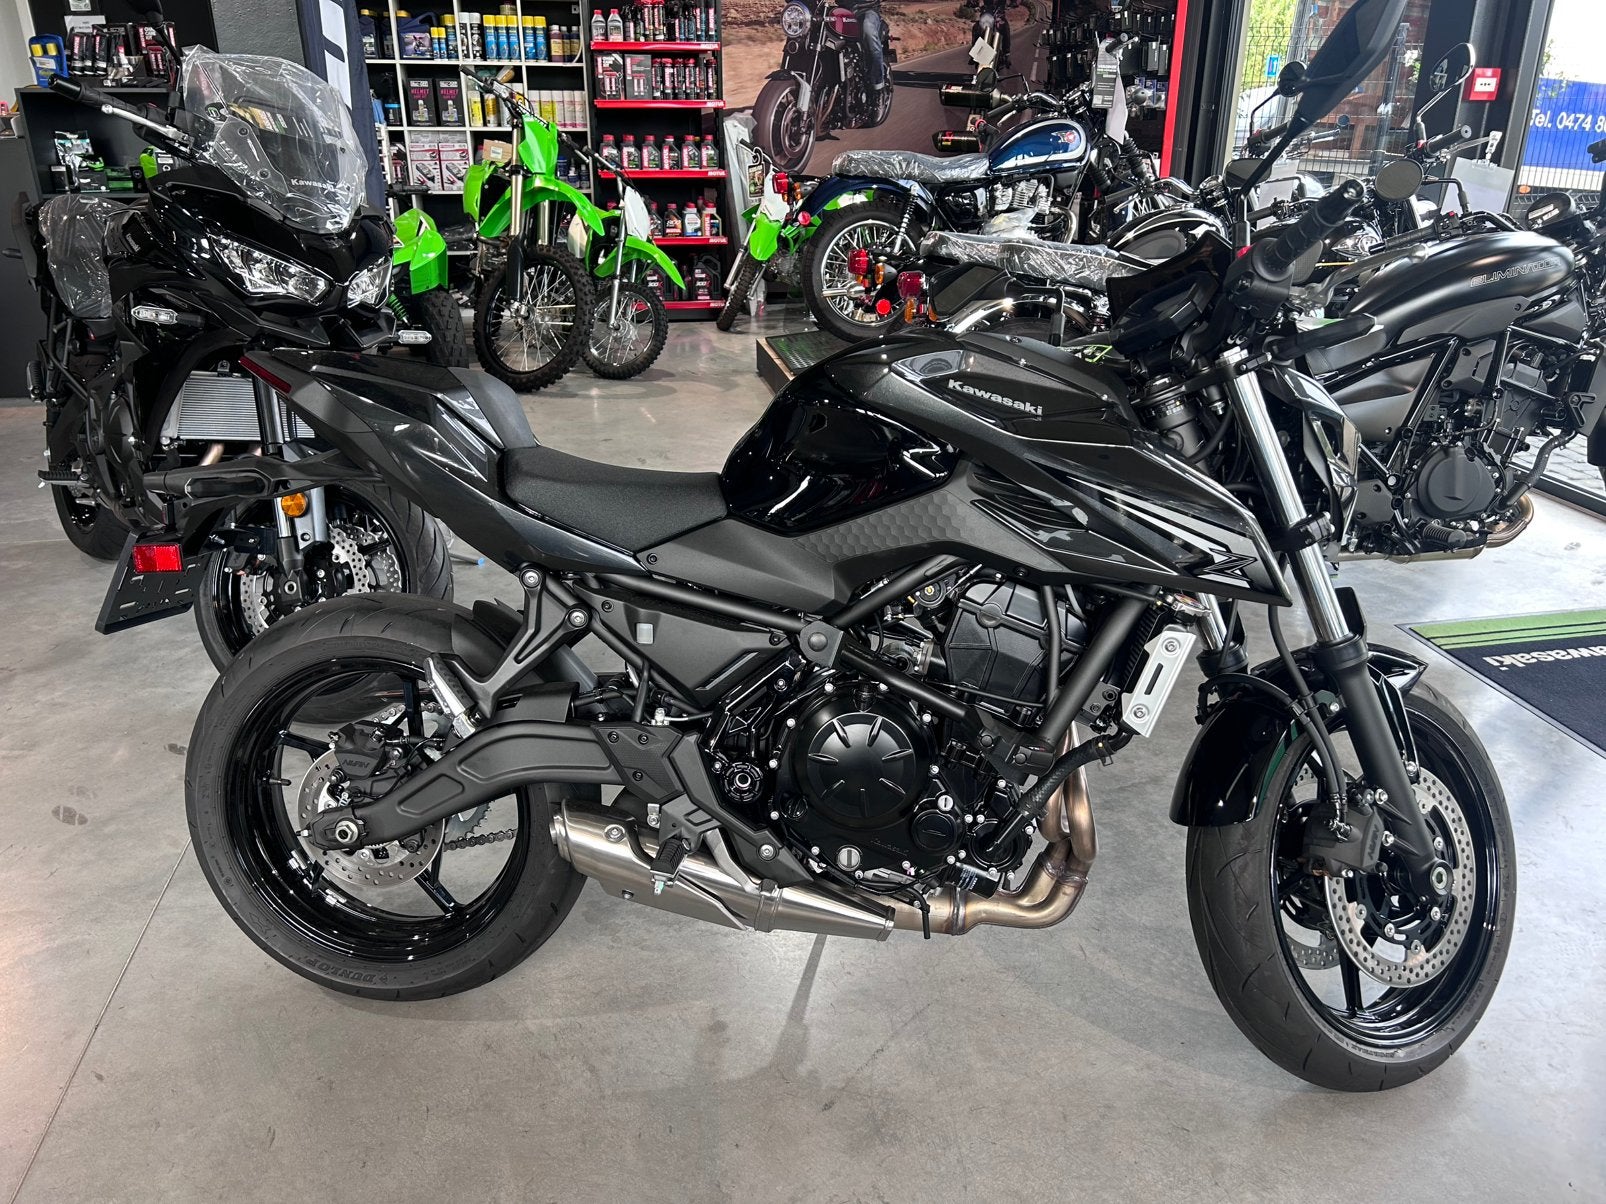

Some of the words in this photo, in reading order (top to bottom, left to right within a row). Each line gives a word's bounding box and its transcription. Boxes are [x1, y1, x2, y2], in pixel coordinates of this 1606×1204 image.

[1556, 111, 1593, 131] 0474
[1595, 115, 1606, 133] 8
[948, 379, 1043, 415] Kawasaki
